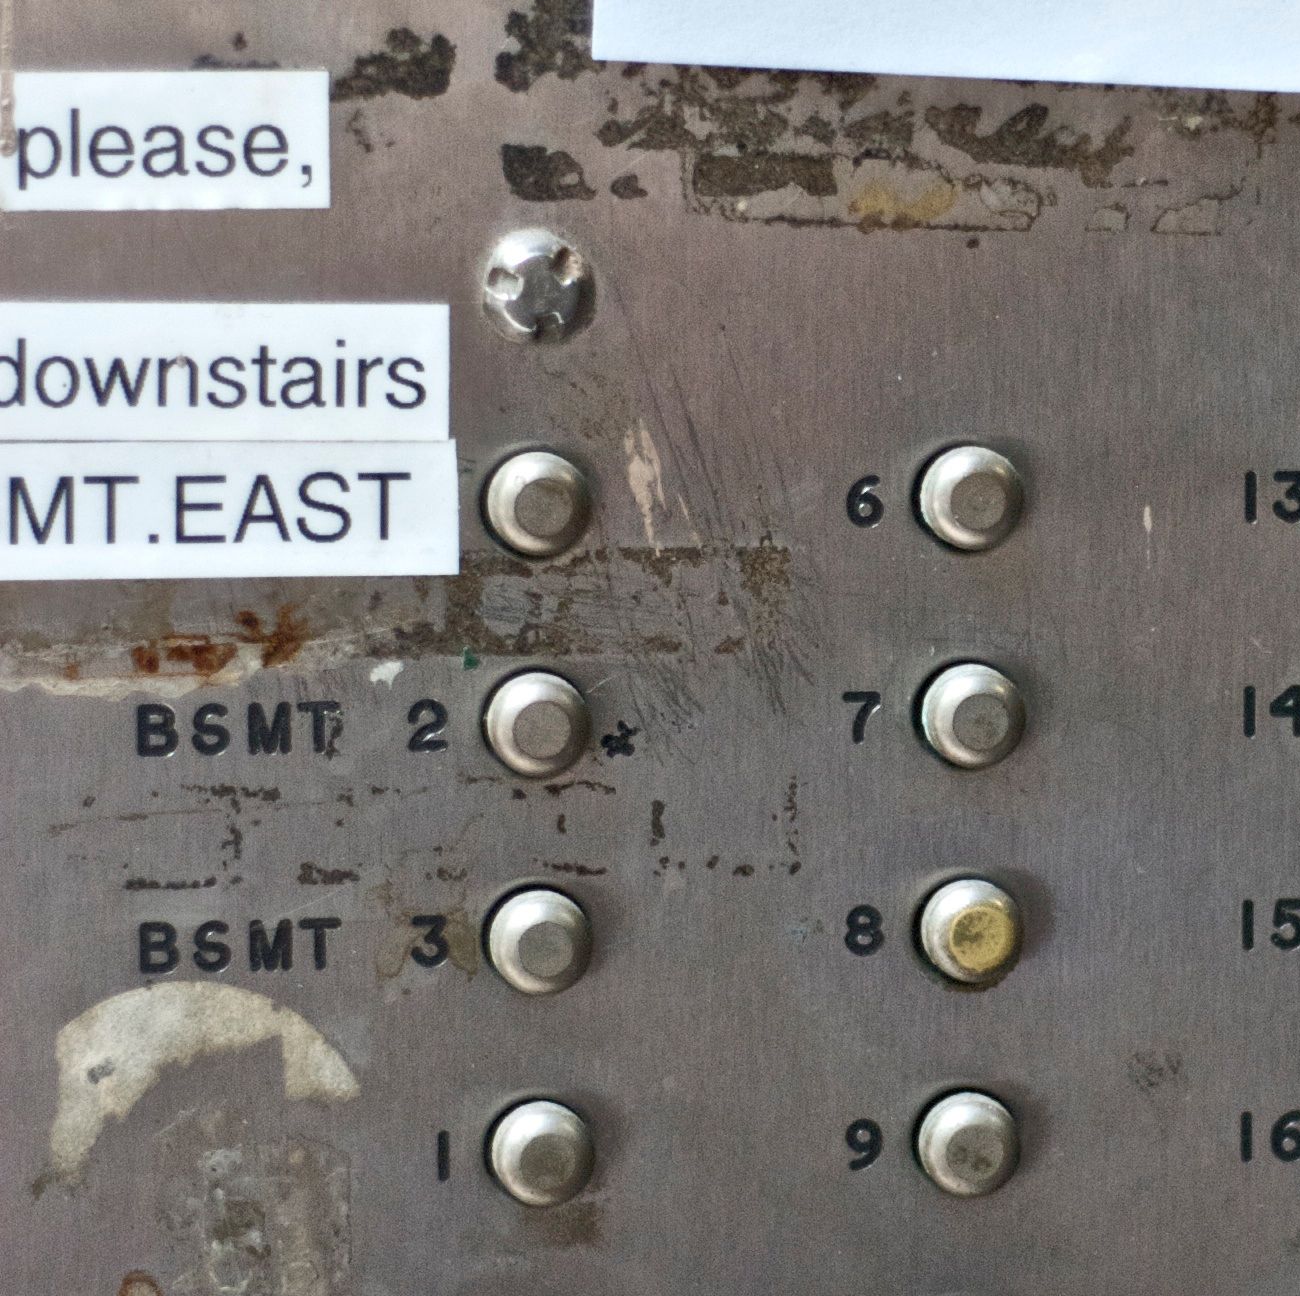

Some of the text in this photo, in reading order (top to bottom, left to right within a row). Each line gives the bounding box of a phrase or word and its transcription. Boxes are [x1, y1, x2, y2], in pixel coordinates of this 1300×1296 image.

[18, 108, 313, 190] please,
[846, 475, 884, 528] 6
[136, 698, 449, 757] BSMT 2
[843, 691, 880, 744] 7
[138, 914, 450, 975] BSMT 3
[845, 906, 884, 956] 8
[437, 1131, 450, 1180] 1
[845, 1120, 883, 1170] 9
